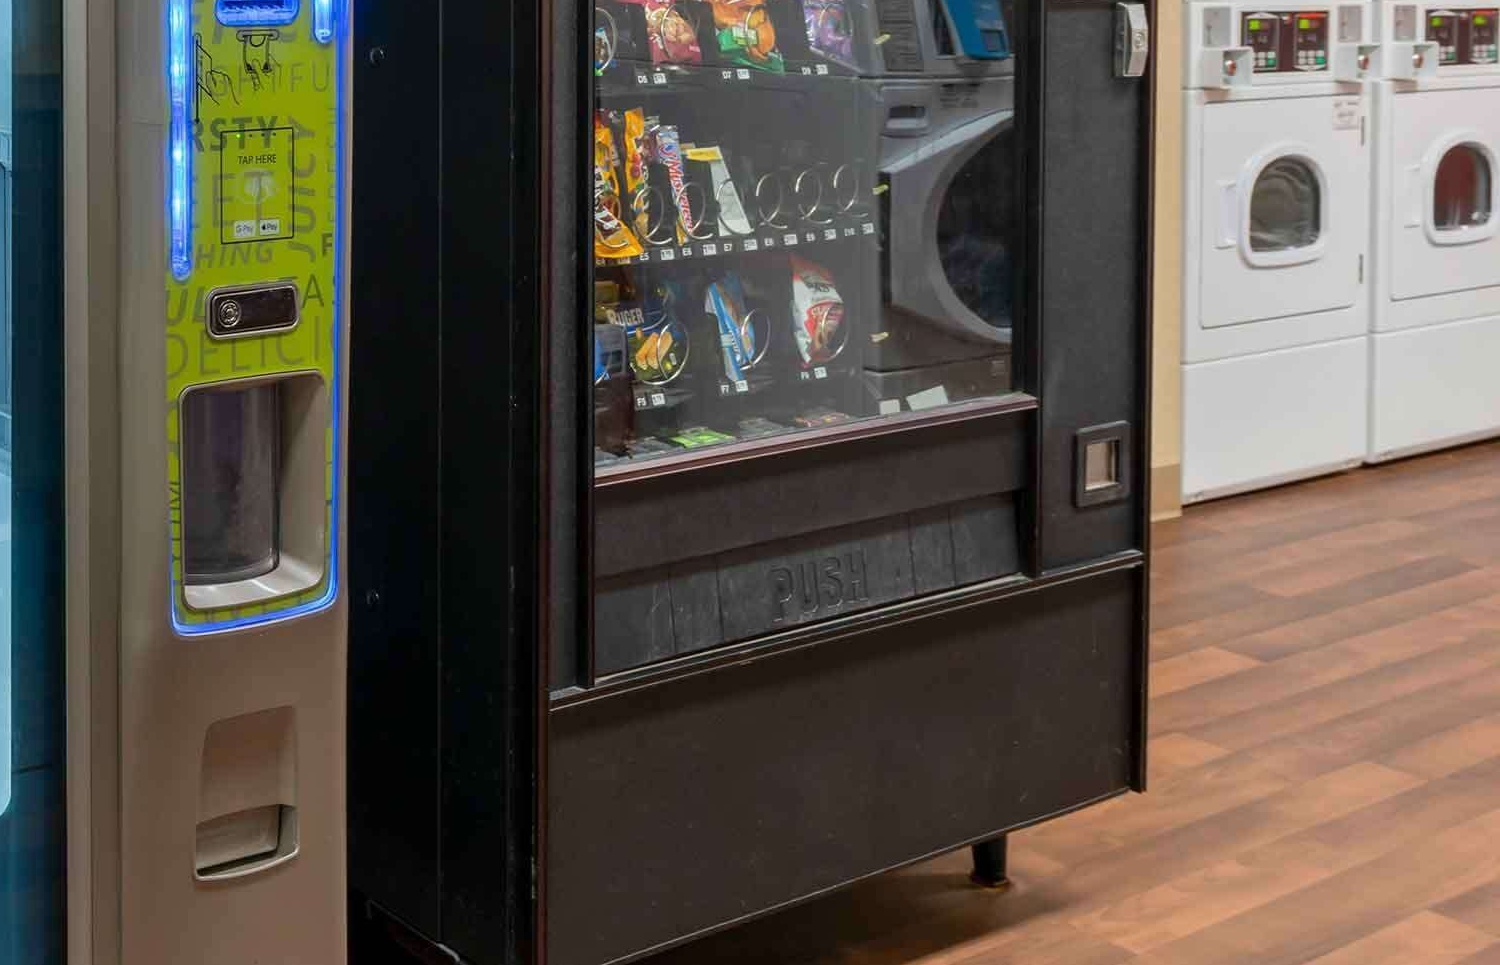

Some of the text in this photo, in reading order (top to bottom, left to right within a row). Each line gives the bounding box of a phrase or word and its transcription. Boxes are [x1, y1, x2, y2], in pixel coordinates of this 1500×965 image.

[237, 153, 277, 164] TAP HERE
[768, 547, 869, 622] PUSH
